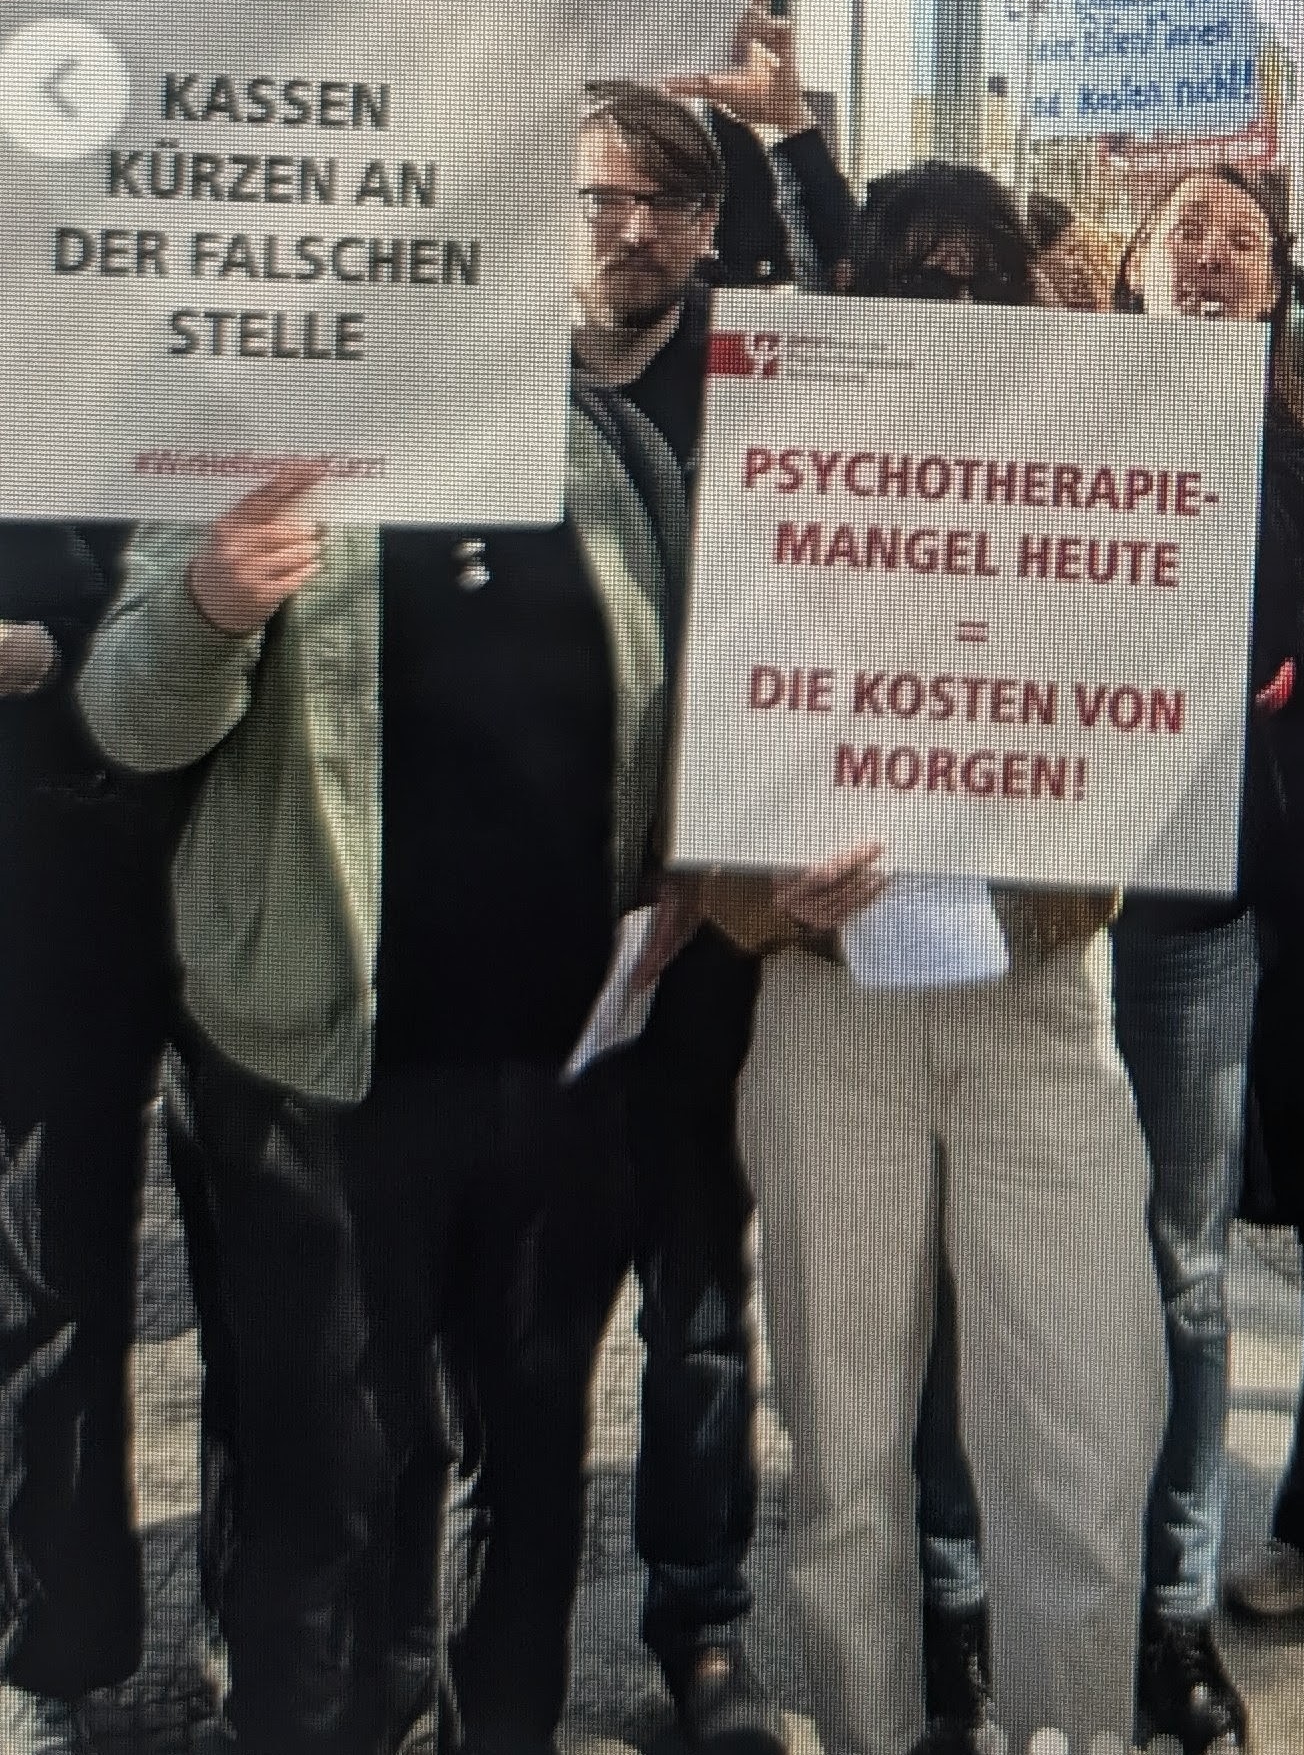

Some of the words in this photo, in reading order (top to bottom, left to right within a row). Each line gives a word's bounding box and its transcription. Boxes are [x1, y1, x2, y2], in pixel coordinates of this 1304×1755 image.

[163, 72, 391, 130] KASSEN
[107, 142, 338, 205] KÜRZEN
[354, 161, 437, 207] AN
[54, 227, 168, 275] DER
[192, 232, 482, 286] FALSCHEN
[169, 309, 365, 360] STELLE
[742, 447, 1219, 517] PSYCHOTHERAPIE-
[775, 521, 1001, 577] MANGEL
[1017, 537, 1181, 587] HEUTE
[749, 665, 833, 711] DIE
[853, 669, 1058, 725] KOSTEN
[1074, 685, 1185, 735] VON
[834, 745, 1088, 801] MORGEN!
